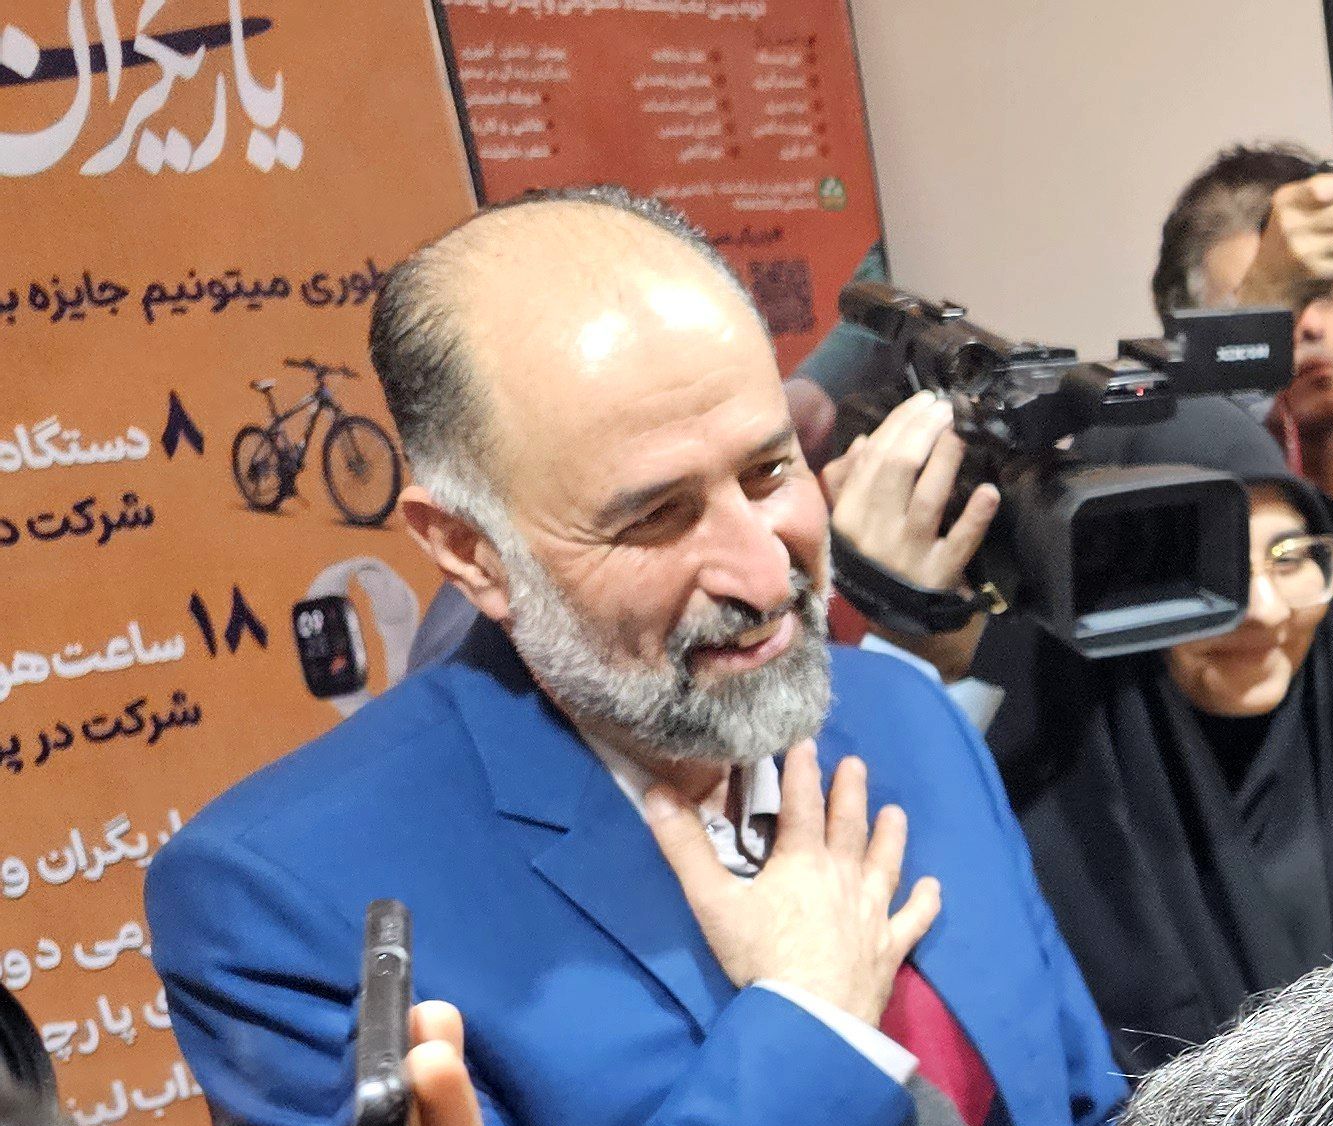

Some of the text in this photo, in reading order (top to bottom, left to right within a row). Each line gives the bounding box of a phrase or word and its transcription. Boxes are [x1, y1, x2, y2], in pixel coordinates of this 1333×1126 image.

[29, 268, 130, 324] جایزه
[142, 268, 292, 325] میتونیم
[301, 257, 388, 307] طوری
[0, 389, 205, 473] ۸ دستگاه
[0, 491, 155, 547] شرکت د
[188, 582, 269, 659] ۱۸
[51, 621, 187, 680] ساعت
[35, 720, 75, 767] در
[81, 690, 203, 747] شرکت
[2, 855, 30, 899] و
[73, 921, 151, 971] می
[42, 994, 137, 1062] پارچ
[131, 1061, 203, 1118] اب
